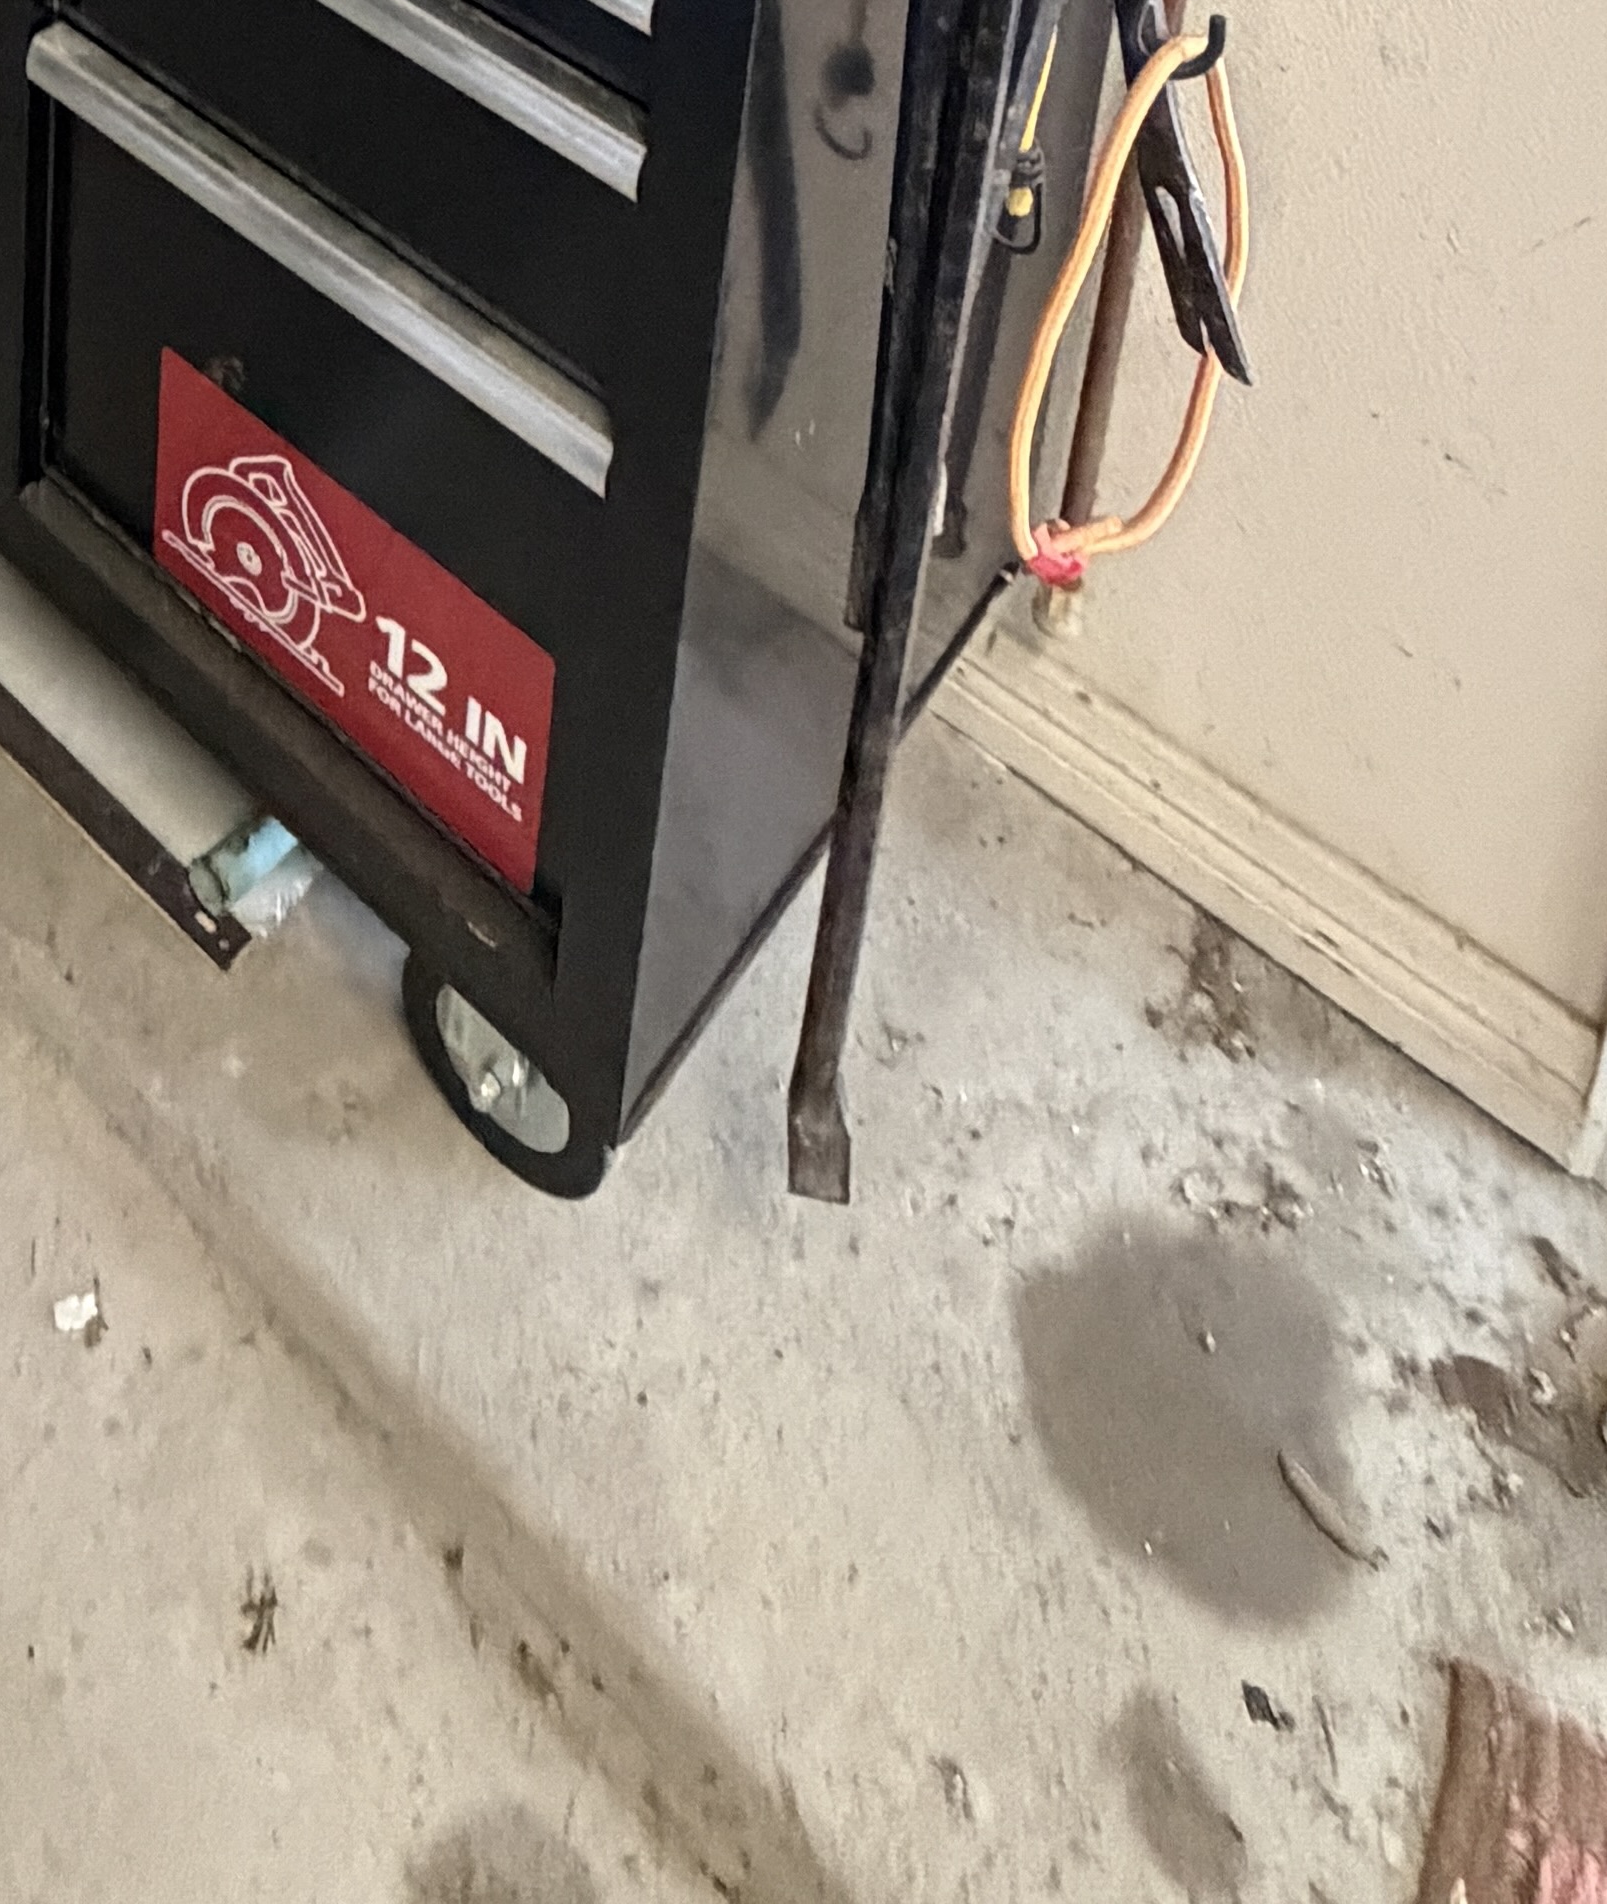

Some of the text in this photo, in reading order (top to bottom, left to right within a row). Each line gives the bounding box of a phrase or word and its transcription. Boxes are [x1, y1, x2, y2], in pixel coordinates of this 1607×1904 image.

[368, 676, 523, 822] FOR LARGE TOOLS
[370, 659, 512, 792] DRAWER HEIGHT
[375, 615, 527, 785] 12 IN
